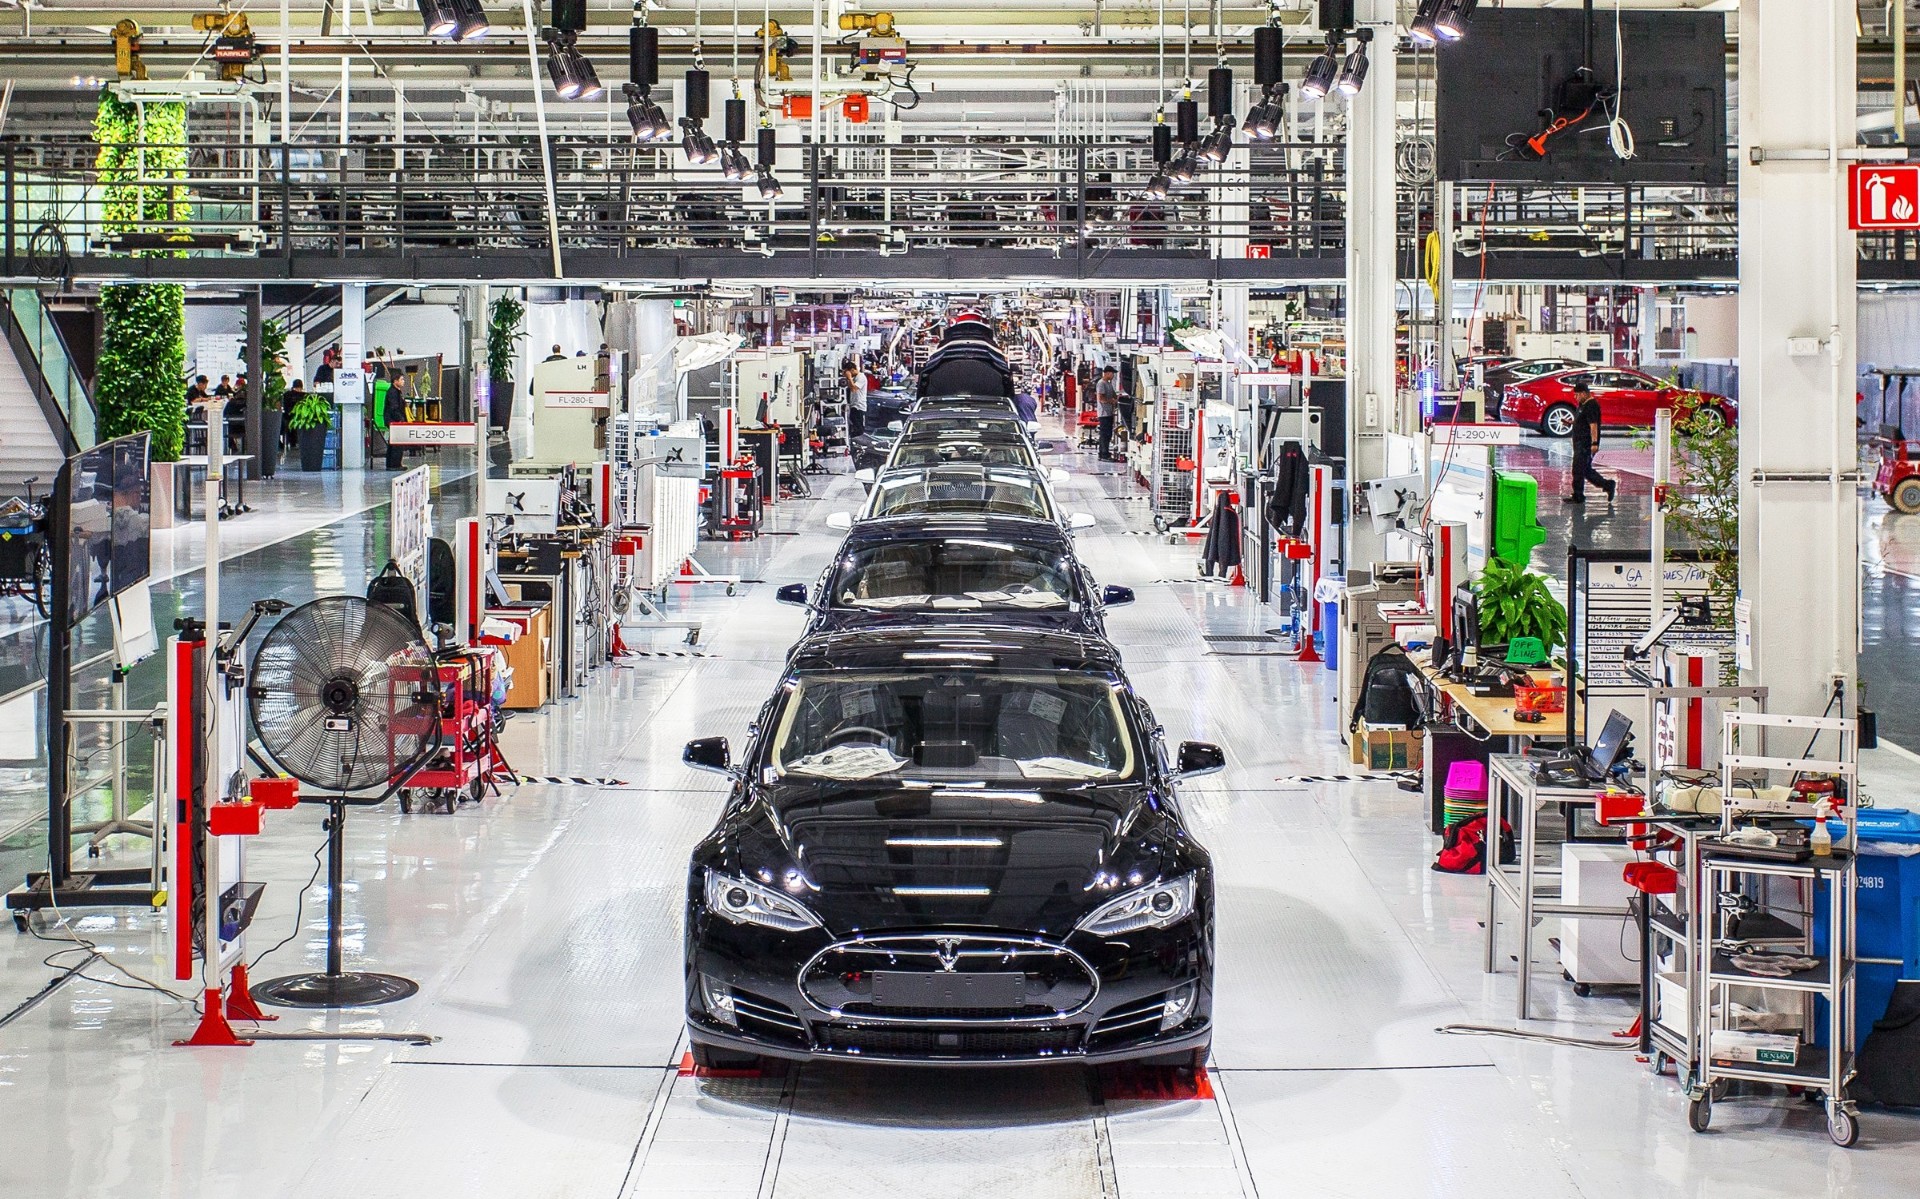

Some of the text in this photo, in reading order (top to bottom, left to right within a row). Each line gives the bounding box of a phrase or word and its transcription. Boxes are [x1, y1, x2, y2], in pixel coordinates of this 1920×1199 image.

[558, 396, 594, 404] FL-280-E
[408, 429, 456, 439] FL-290-E
[1626, 567, 1643, 582] GA
[1514, 640, 1533, 649] OFF
[1513, 649, 1538, 659] LINE
